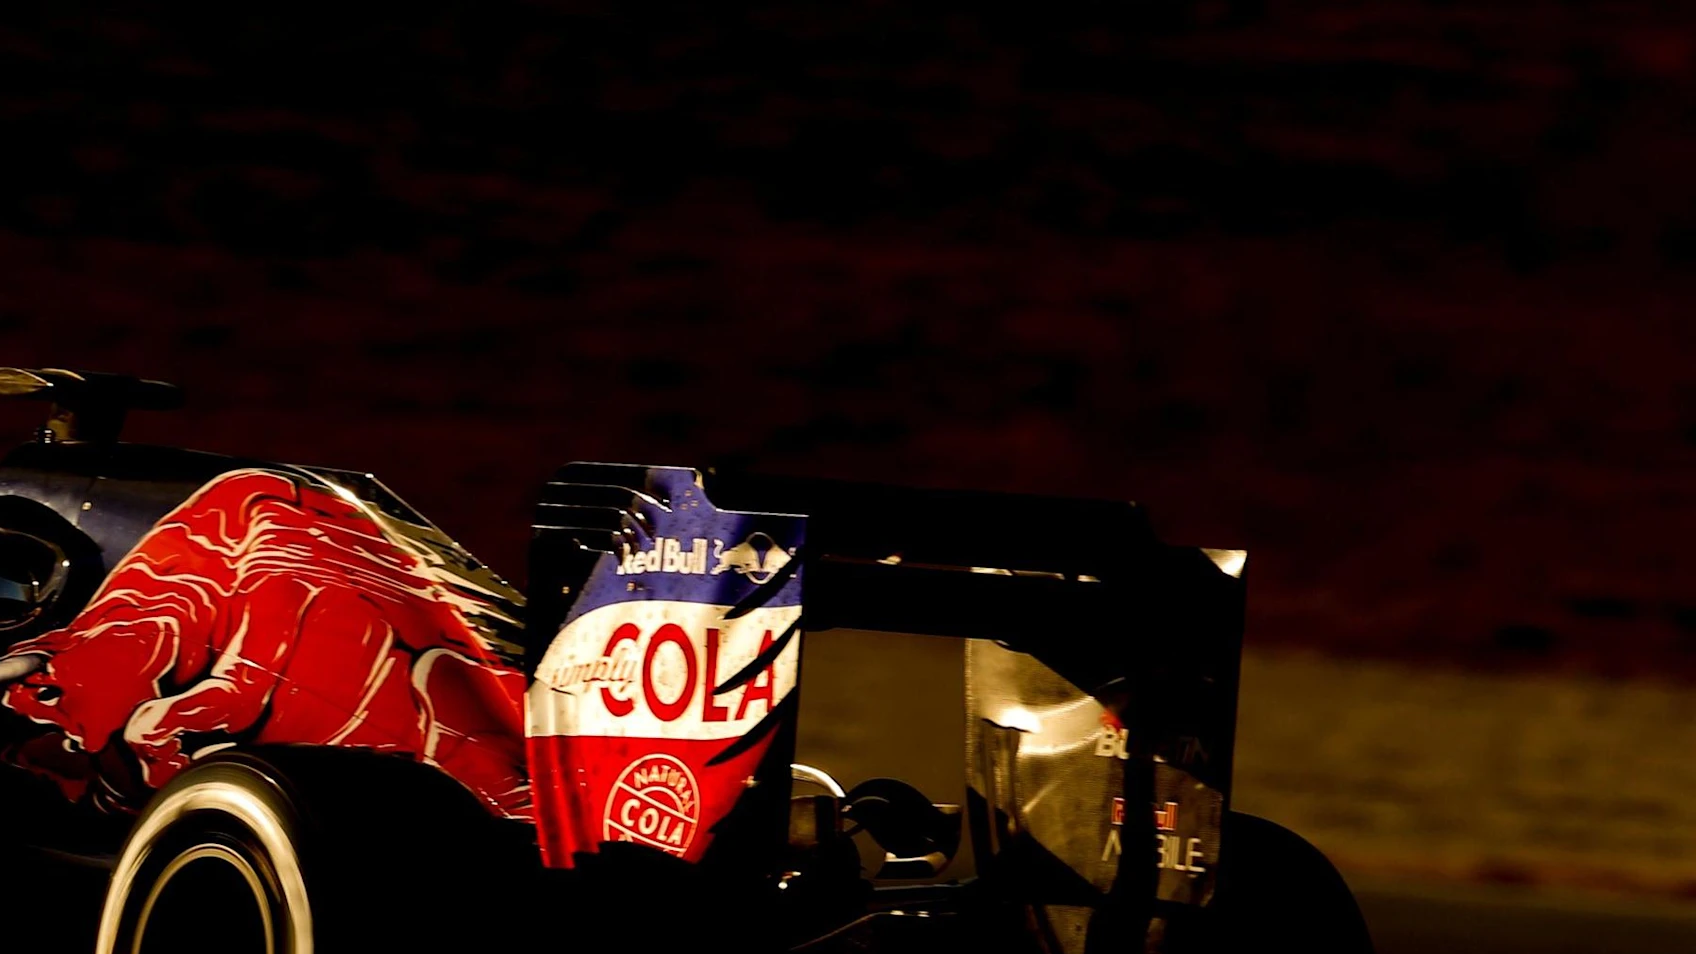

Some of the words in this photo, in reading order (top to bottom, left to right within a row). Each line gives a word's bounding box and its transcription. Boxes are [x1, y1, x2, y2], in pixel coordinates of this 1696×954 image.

[662, 537, 708, 575] Bull
[600, 622, 776, 723] COLA
[633, 765, 695, 812] NATURAL
[620, 798, 685, 845] COLA
